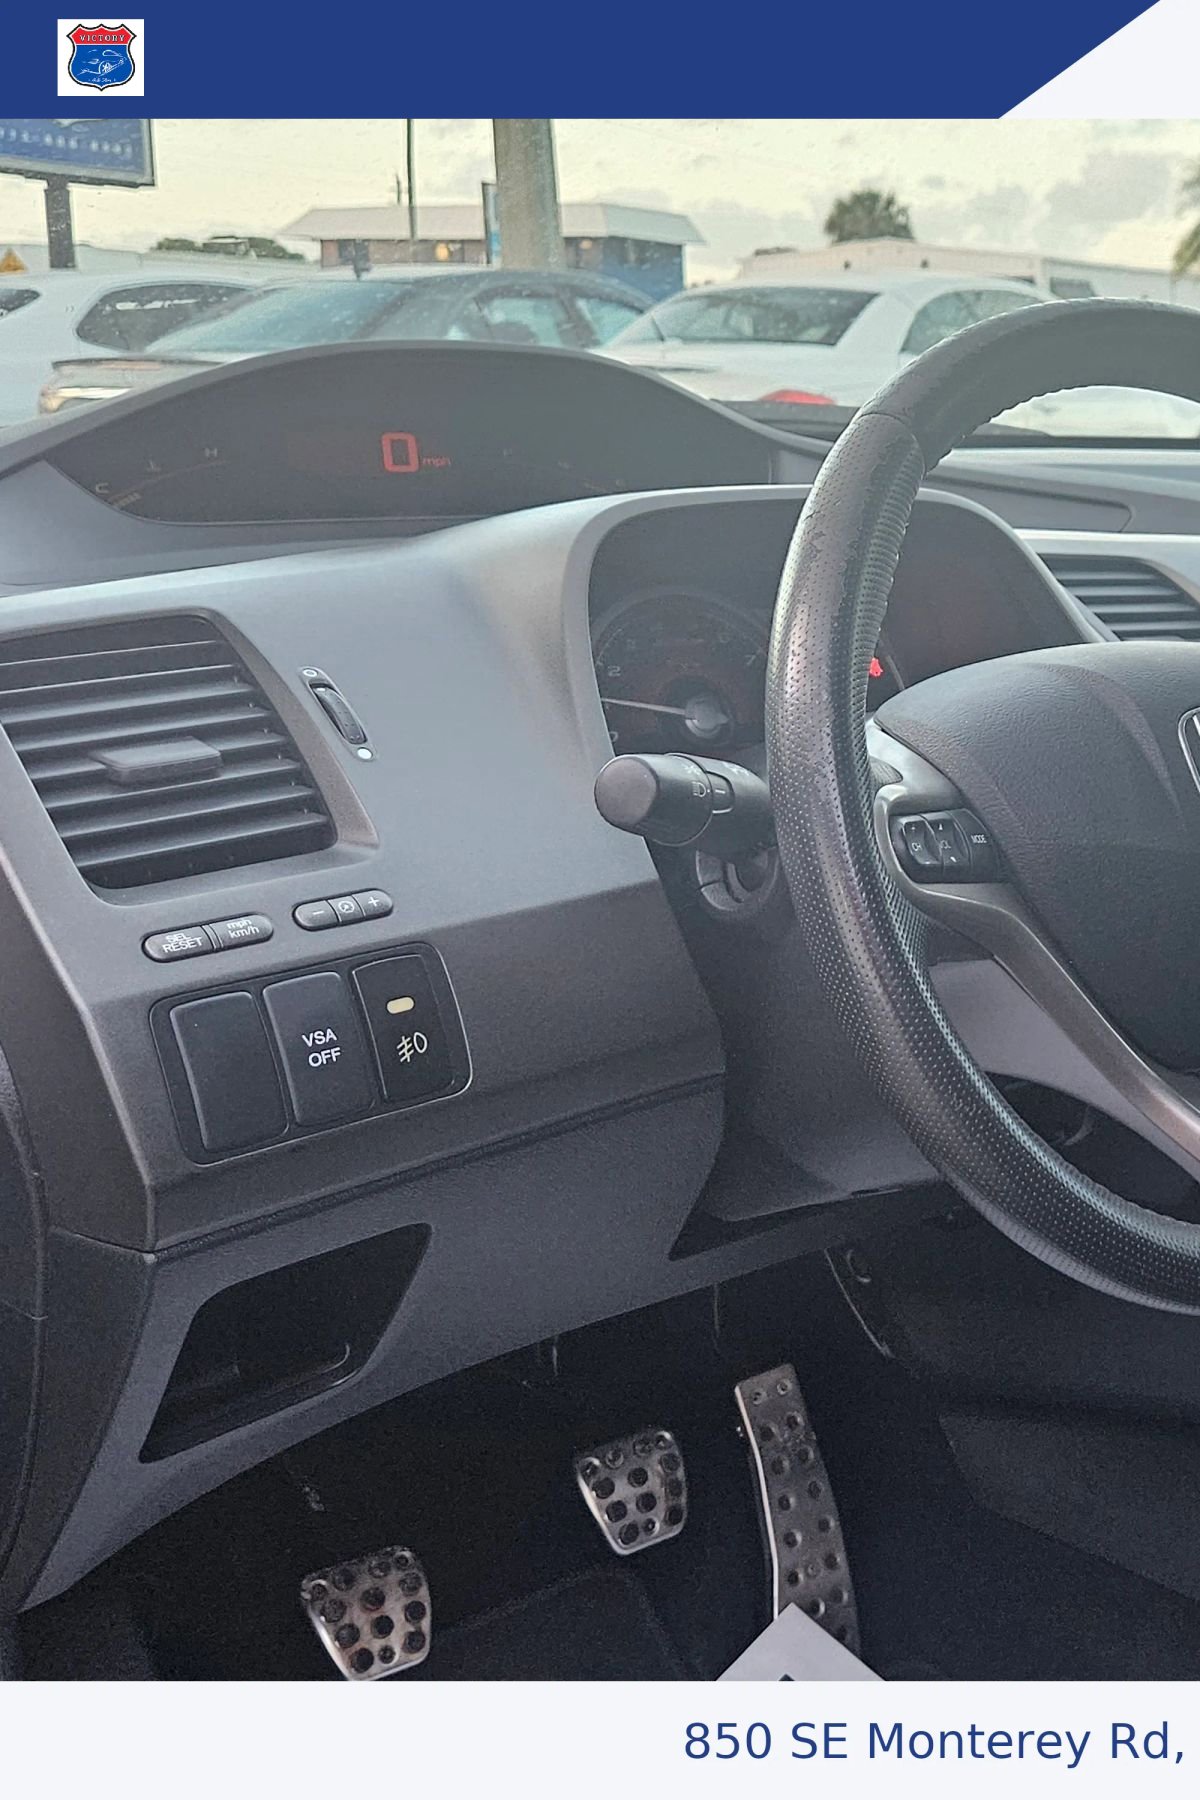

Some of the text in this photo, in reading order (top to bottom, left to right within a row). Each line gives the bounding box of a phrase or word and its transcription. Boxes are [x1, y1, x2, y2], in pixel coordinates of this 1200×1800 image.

[381, 432, 419, 472] 0
[607, 665, 622, 677] 2
[226, 919, 252, 931] mph
[228, 925, 260, 939] km/h
[162, 937, 203, 954] RESET
[166, 933, 192, 943] SEL
[301, 1028, 338, 1048] VSA
[308, 1047, 341, 1068] OFF
